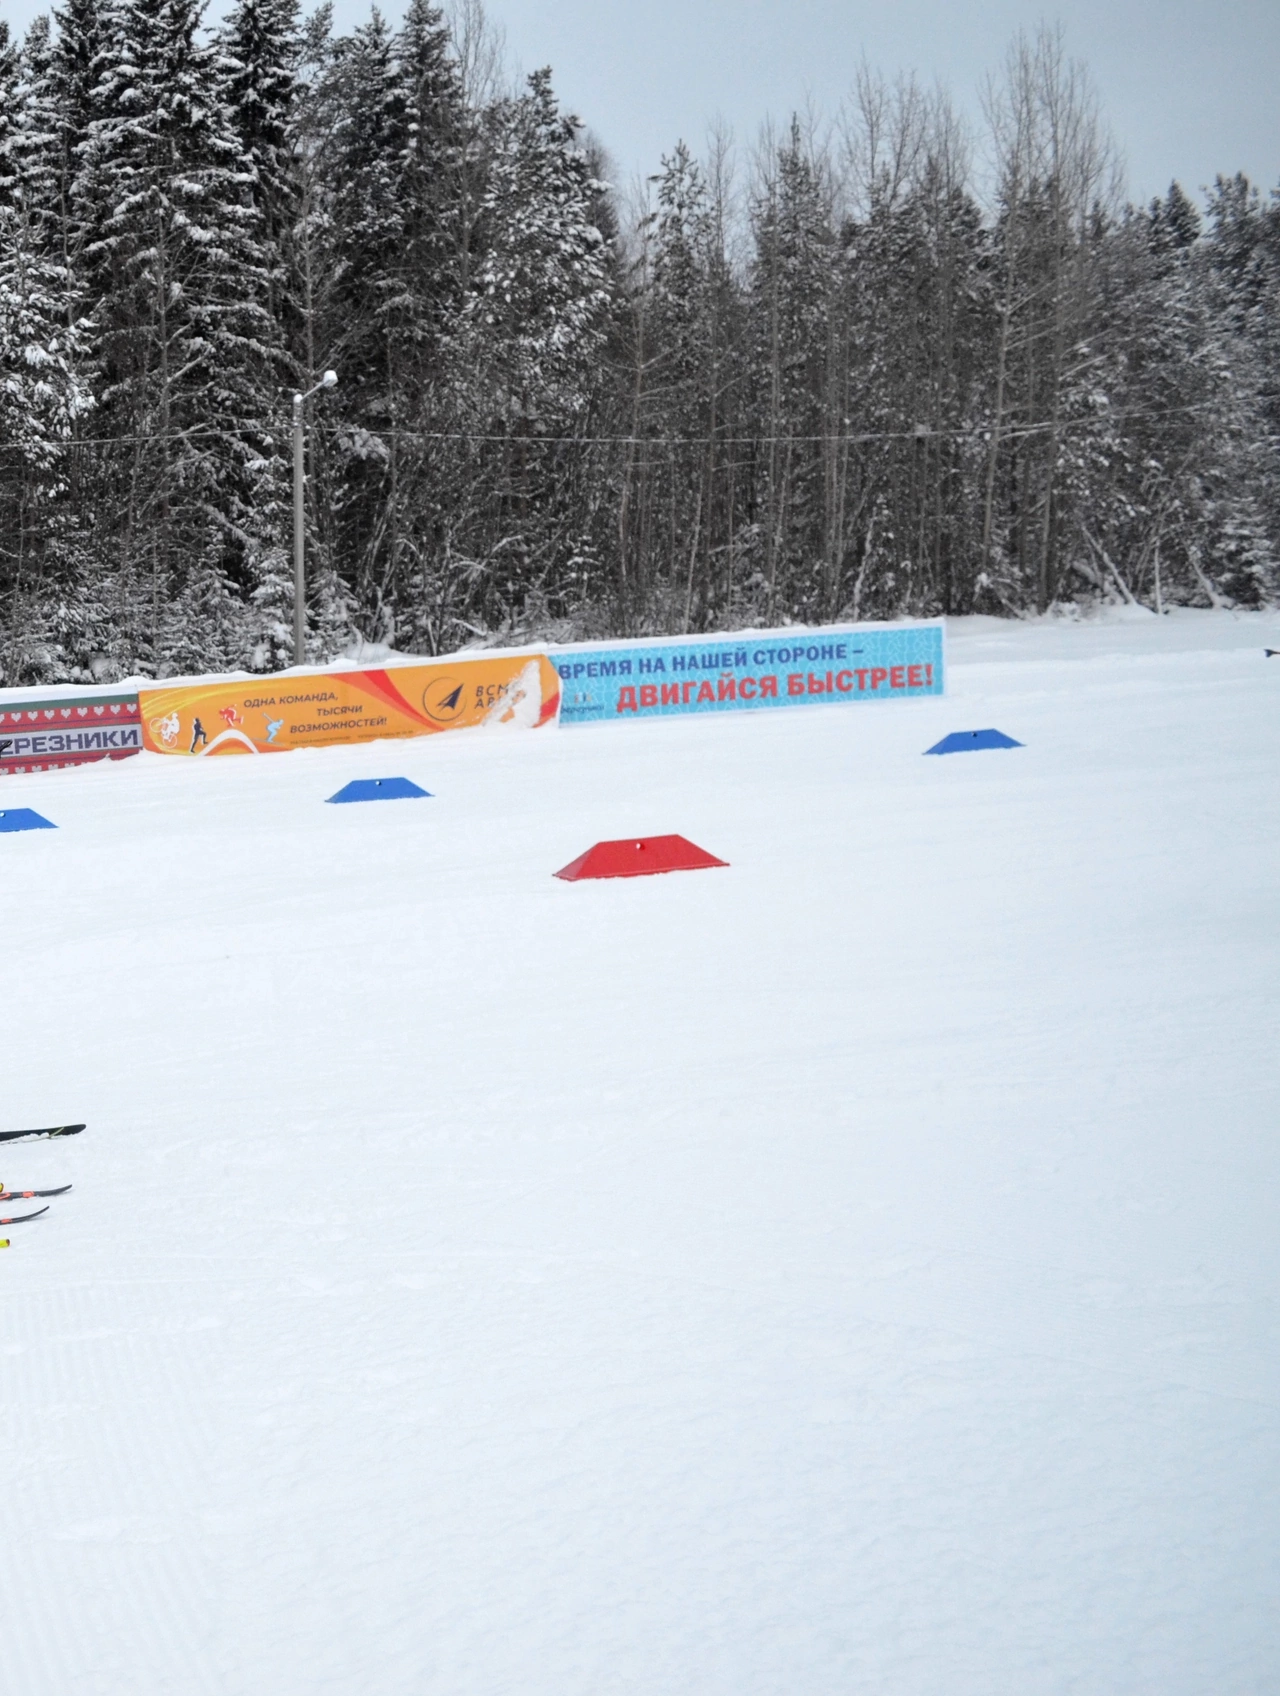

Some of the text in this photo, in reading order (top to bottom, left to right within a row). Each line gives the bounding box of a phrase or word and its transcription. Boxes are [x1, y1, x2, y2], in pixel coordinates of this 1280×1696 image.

[559, 659, 632, 680] ВРЕМЯ
[639, 657, 666, 674] НА
[673, 646, 747, 671] НАШЕЙ
[753, 644, 848, 666] СТОРОНЕ
[617, 664, 933, 713] ДВИГАЙСЯ БЫСТРЕЕ!
[244, 692, 339, 708] ОДНА КОМАНДА,
[317, 705, 363, 717] ТЫСЯЧИ
[290, 717, 387, 734] ВОЗМОЖНОСТЕЙ!
